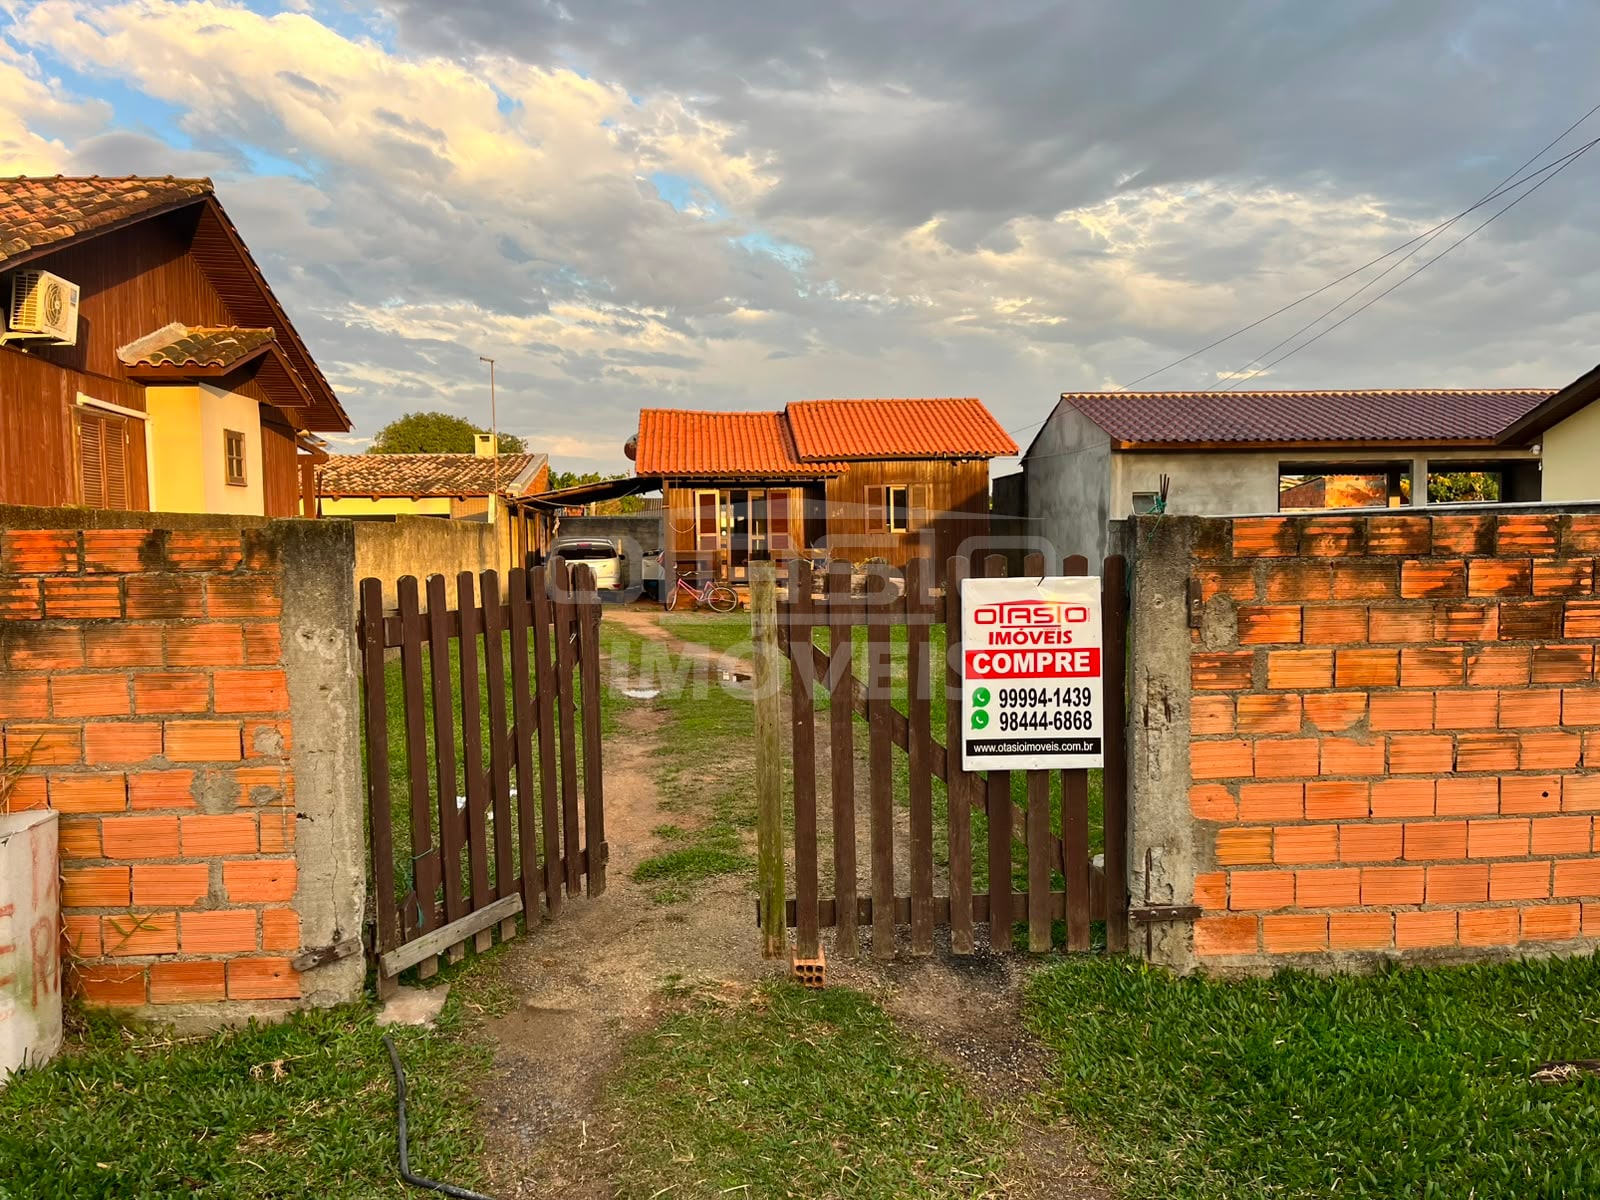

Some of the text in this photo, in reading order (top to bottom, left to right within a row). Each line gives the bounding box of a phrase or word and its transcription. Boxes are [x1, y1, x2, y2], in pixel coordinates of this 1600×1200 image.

[974, 604, 1087, 625] OTASIO
[988, 628, 1073, 646] IMÓVEIS
[972, 651, 1091, 674] COMPRE
[999, 687, 1092, 708] 99994-1439
[999, 710, 1093, 732] 98444-6868
[973, 741, 1094, 753] www.otasioimoveis.com.br
